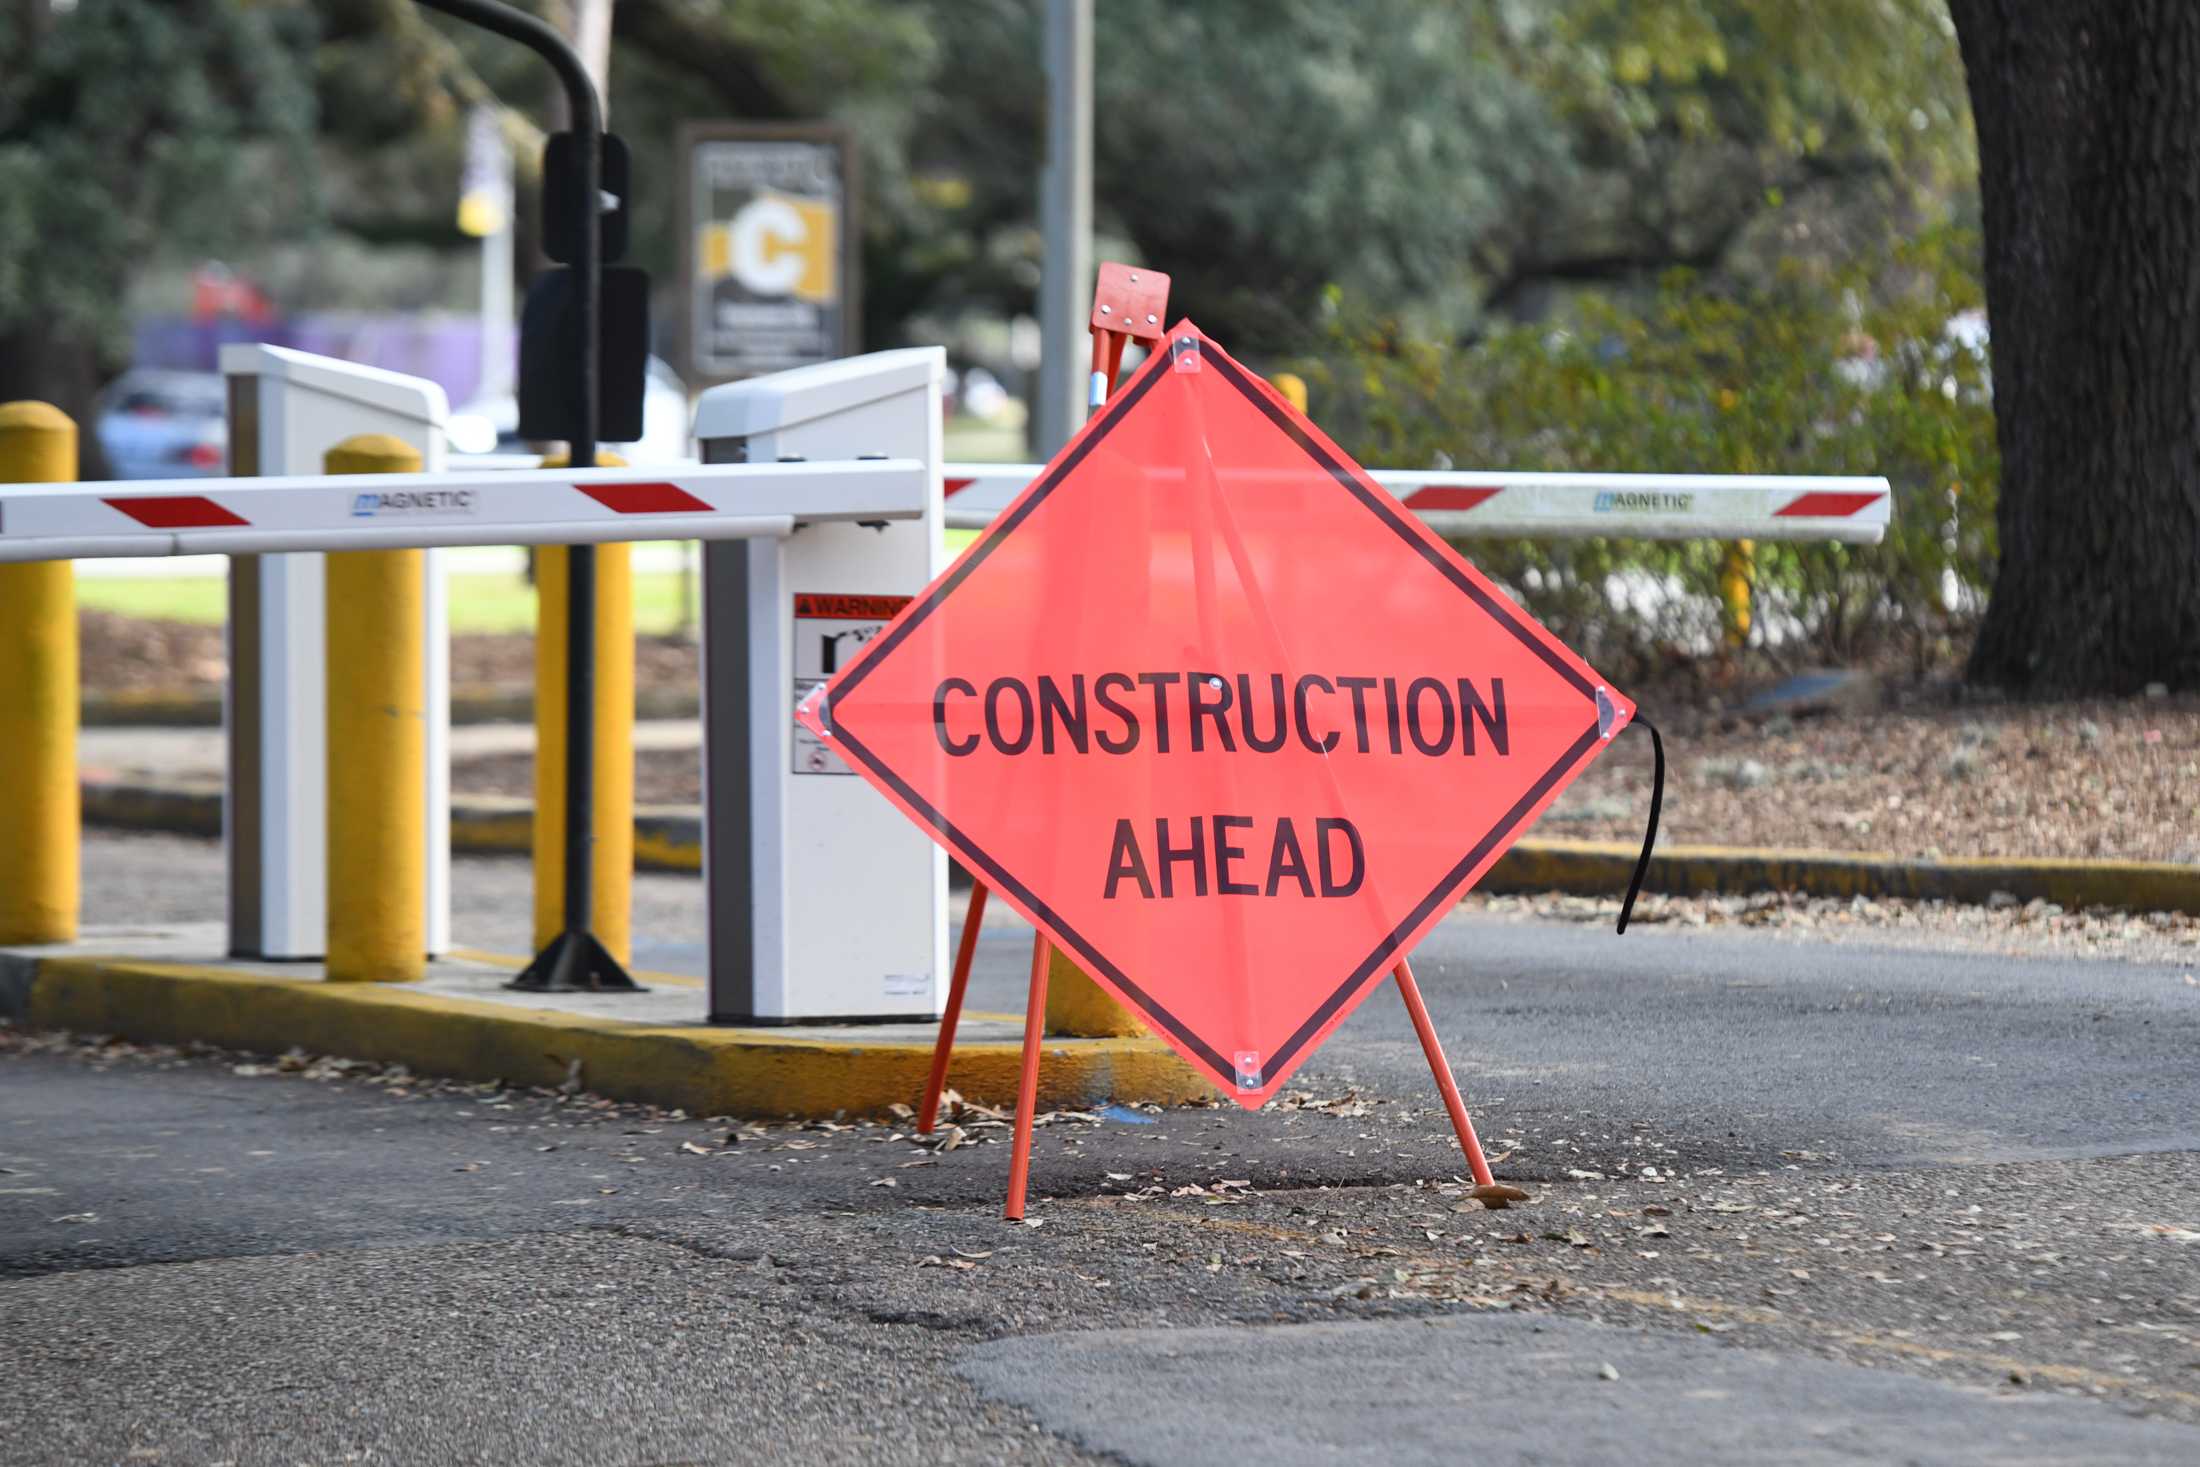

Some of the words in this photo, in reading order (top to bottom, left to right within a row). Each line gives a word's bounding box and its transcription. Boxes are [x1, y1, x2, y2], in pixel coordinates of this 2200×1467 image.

[733, 198, 806, 294] C
[932, 671, 1510, 757] CONSTRUCTION
[1103, 815, 1366, 899] AHEAD
